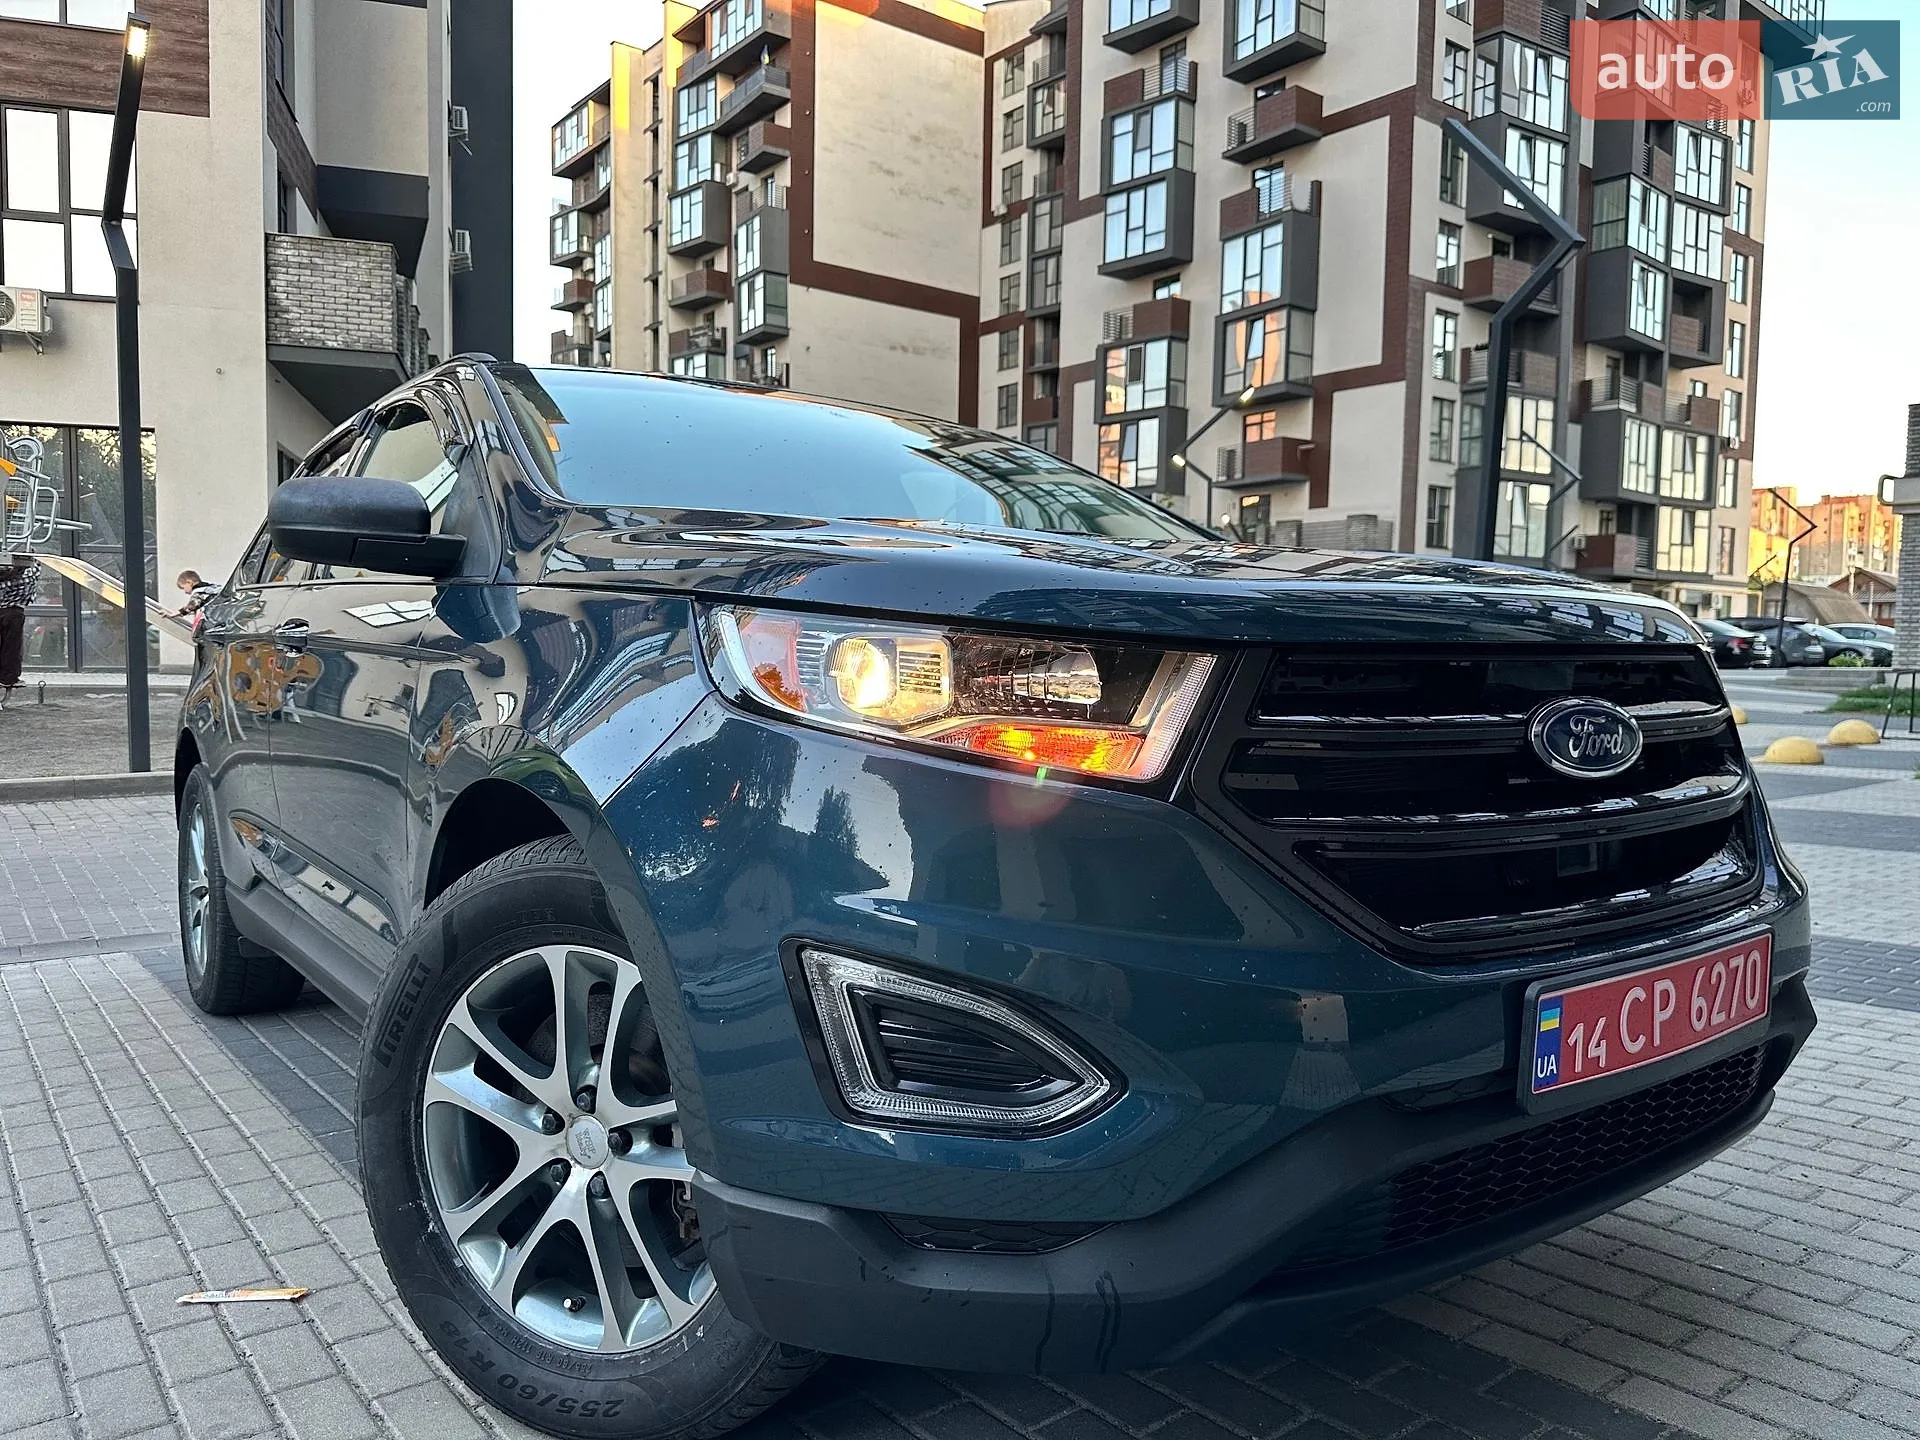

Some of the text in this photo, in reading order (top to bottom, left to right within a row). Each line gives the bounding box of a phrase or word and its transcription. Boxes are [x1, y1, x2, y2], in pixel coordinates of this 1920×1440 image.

[1568, 714, 1625, 759] Ford
[371, 953, 432, 1069] PIRELLI
[1567, 949, 1762, 1073] 14 CP 6270
[1537, 1054, 1558, 1079] UA
[498, 1373, 625, 1418] 255/60
